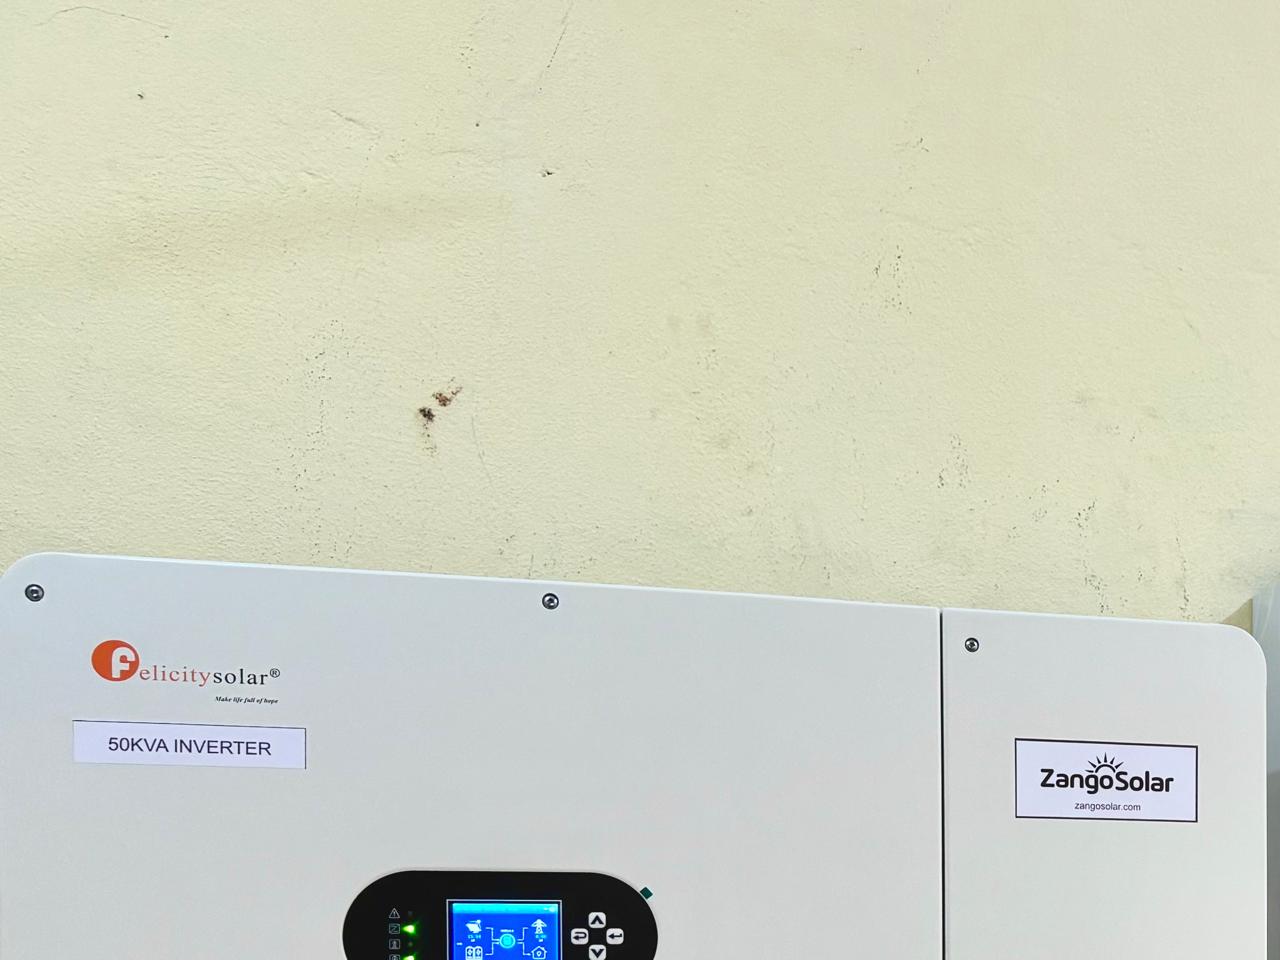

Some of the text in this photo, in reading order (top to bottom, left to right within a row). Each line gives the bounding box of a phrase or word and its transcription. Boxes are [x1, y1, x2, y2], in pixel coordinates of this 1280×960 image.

[108, 737, 272, 756] 50KVA INVERTER
[1040, 768, 1174, 794] ZangoSolar
[1074, 801, 1141, 812] zangosolar.com
